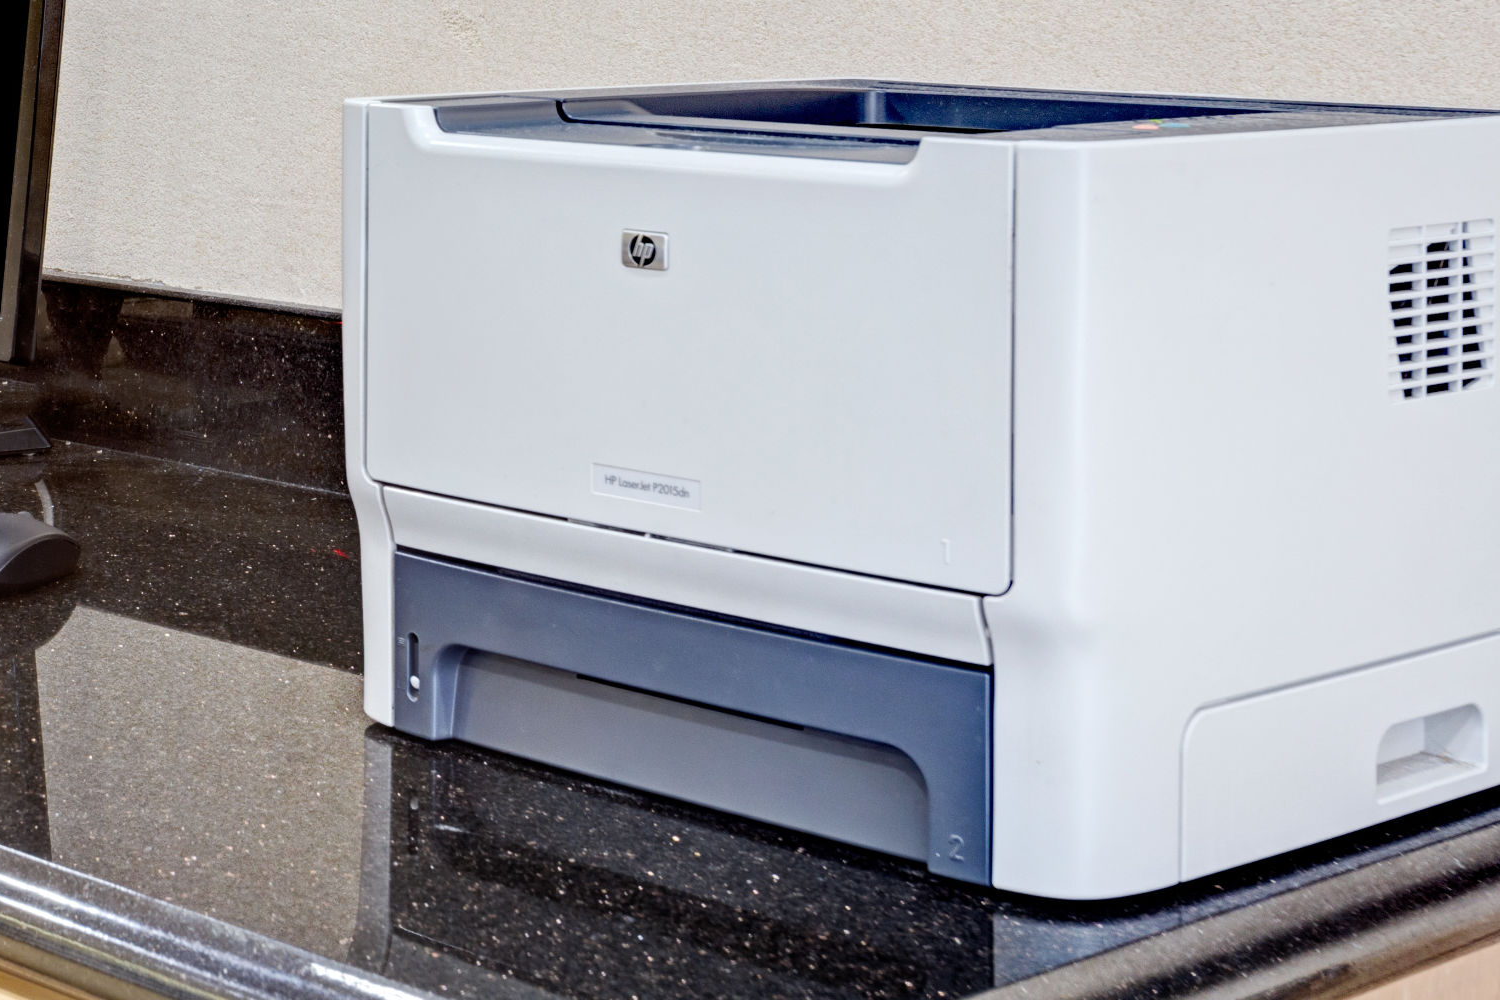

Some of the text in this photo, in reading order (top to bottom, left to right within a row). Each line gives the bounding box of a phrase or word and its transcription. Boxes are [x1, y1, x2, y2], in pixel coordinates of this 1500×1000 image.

[631, 234, 656, 267] hp
[604, 474, 690, 498] HP LaserJet P2015dn
[939, 538, 952, 565] 1
[948, 834, 965, 862] 2
